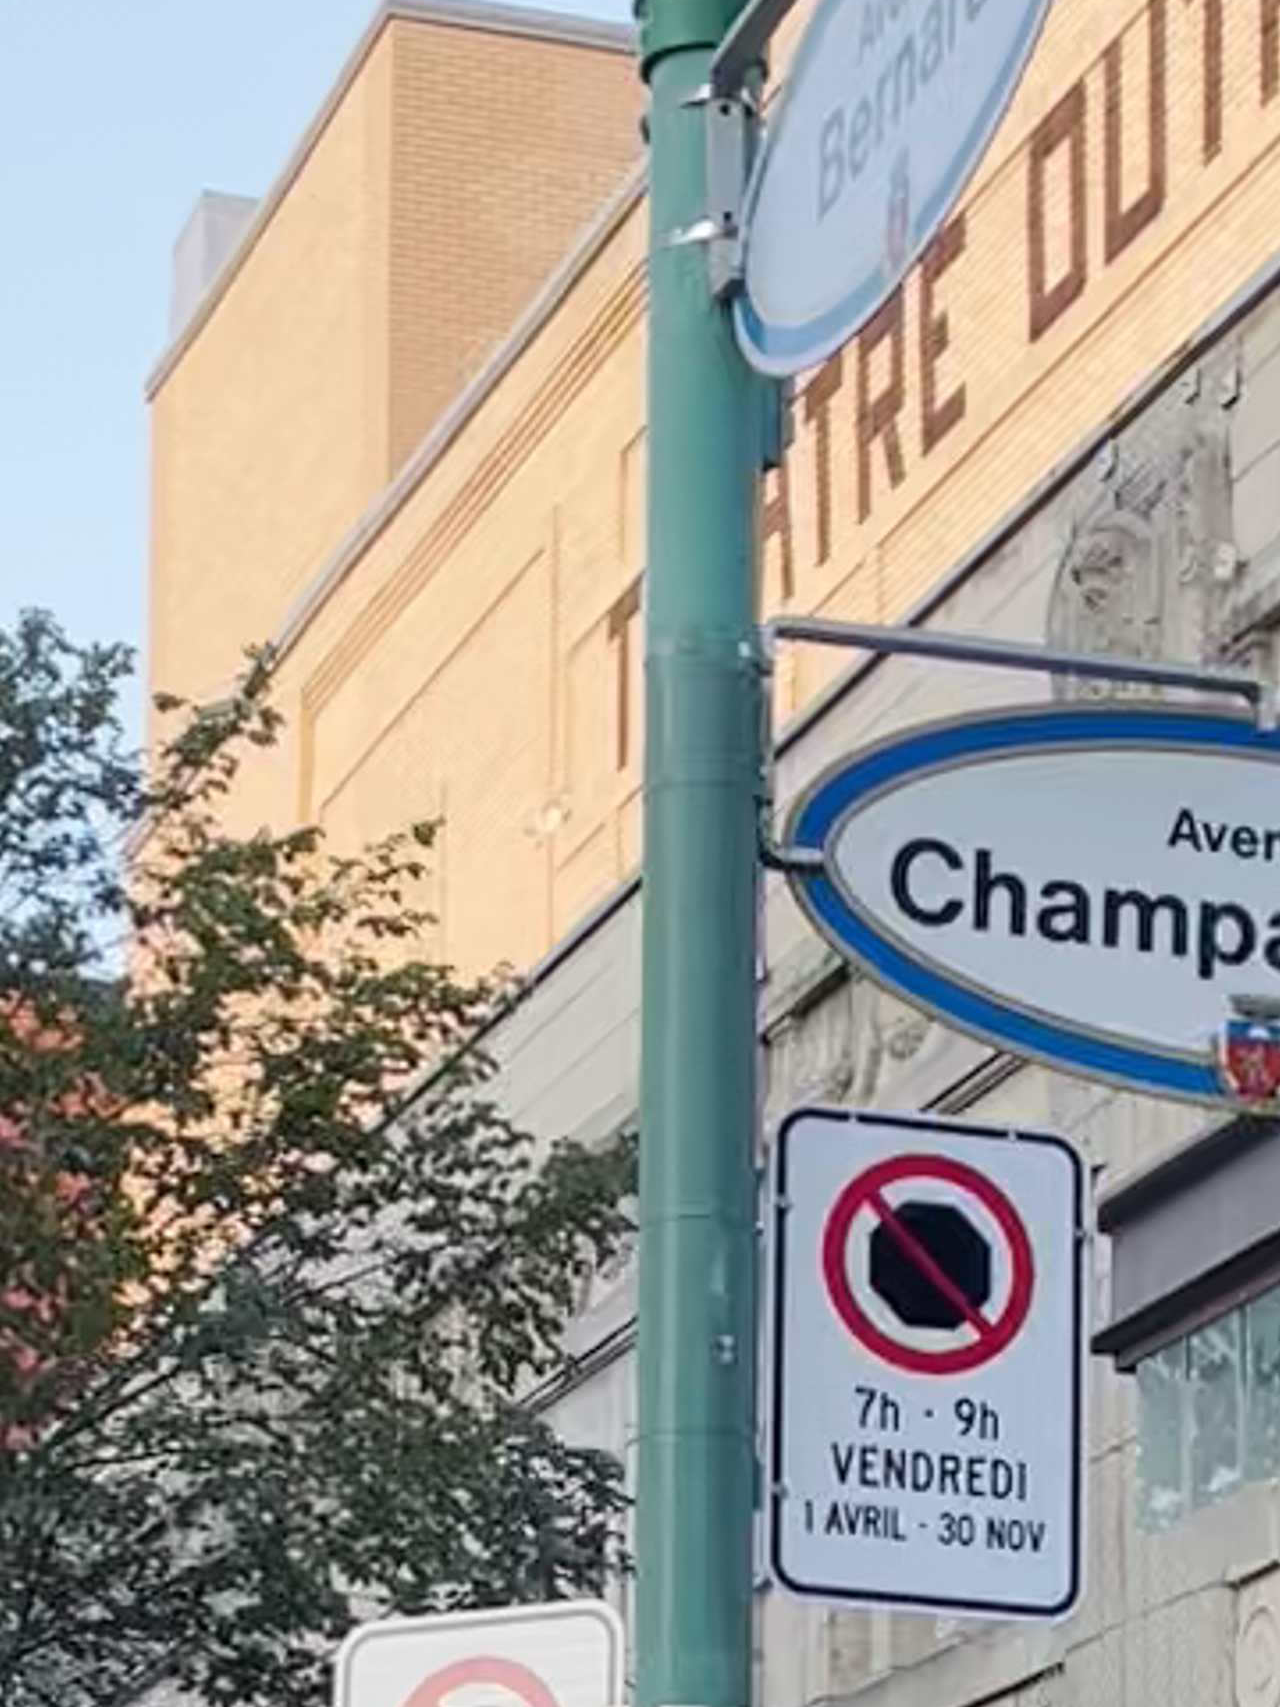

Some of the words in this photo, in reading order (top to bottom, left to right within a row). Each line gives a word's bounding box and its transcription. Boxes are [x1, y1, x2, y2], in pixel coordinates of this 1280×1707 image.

[854, 1384, 901, 1433] 7h
[953, 1396, 1000, 1442] 9h
[831, 1441, 1028, 1501] VENDREDI
[824, 1501, 907, 1543] AVRIL
[937, 1510, 976, 1548] 30
[985, 1516, 1046, 1553] NOV
